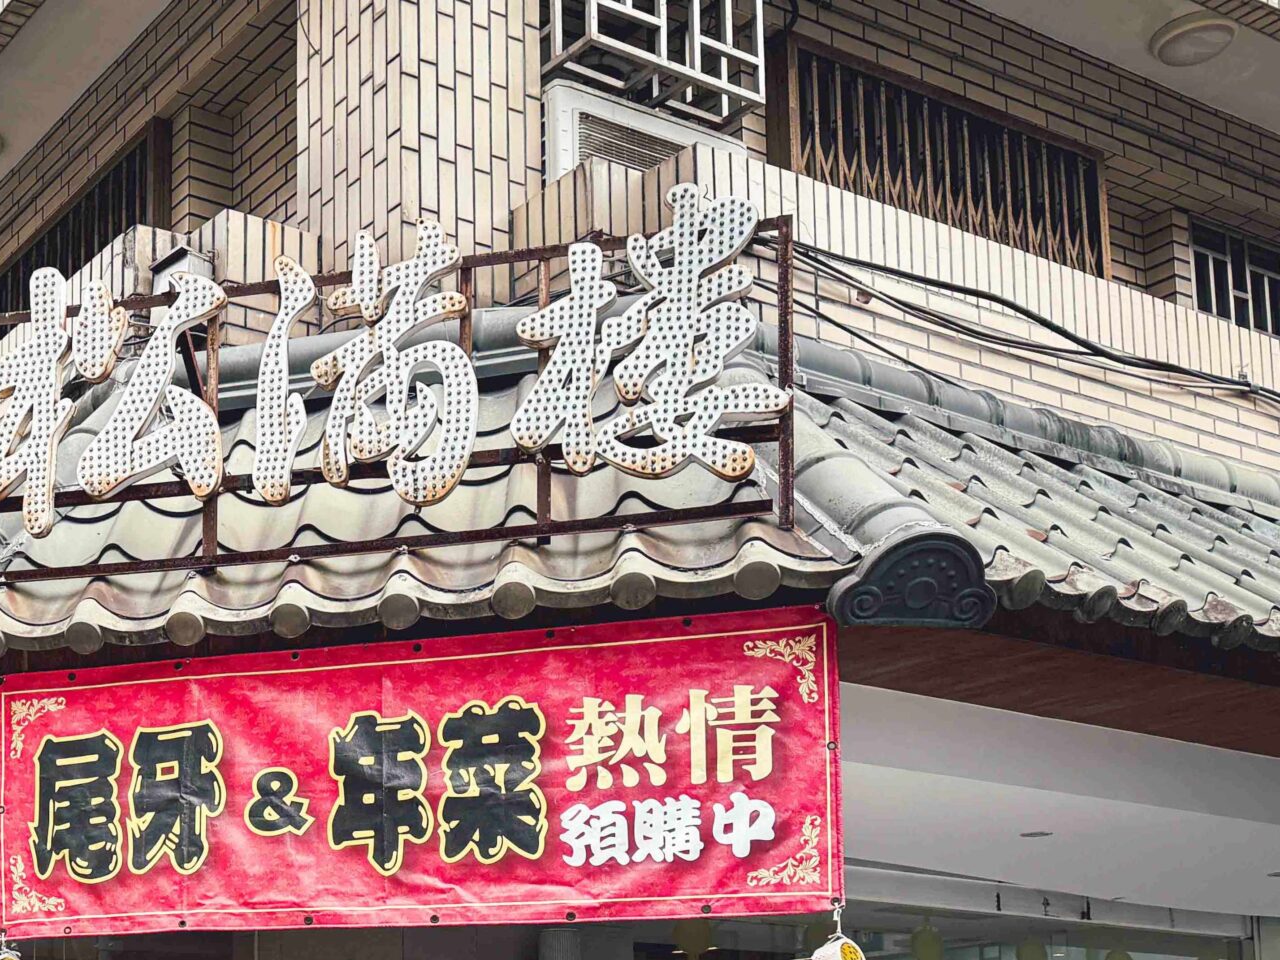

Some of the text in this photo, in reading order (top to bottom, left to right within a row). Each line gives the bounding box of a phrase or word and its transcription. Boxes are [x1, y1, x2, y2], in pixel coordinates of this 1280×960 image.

[30, 694, 549, 884] 尾牙 & 年菜
[565, 684, 782, 793] 熱情
[559, 791, 777, 868] 預購中
